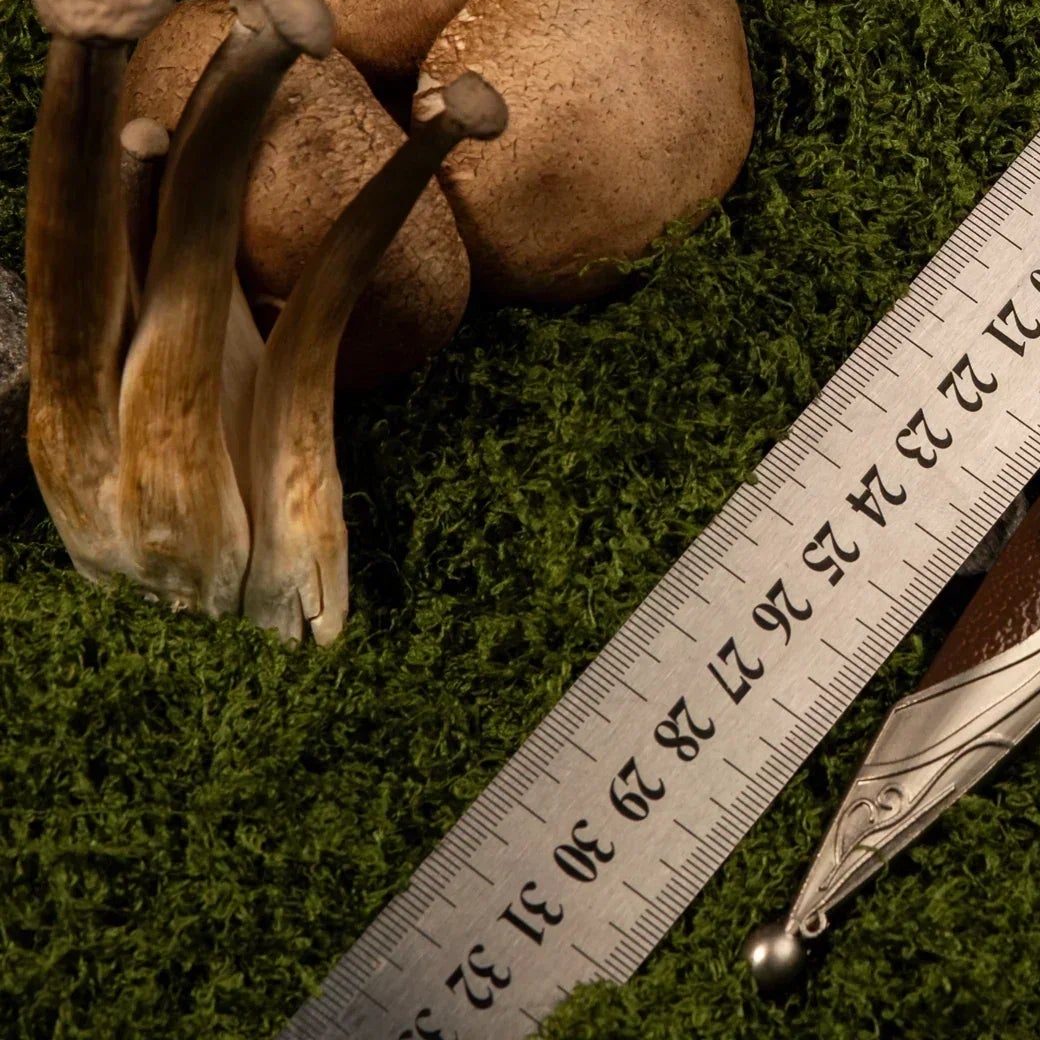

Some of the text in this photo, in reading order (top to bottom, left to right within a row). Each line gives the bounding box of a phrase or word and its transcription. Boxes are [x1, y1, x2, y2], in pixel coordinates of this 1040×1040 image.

[937, 353, 998, 412] 22
[896, 408, 953, 468] 23
[846, 464, 907, 527] 24
[803, 521, 860, 587] 25
[752, 578, 812, 646] 26
[707, 637, 764, 705] 27
[654, 696, 716, 761] 28
[609, 757, 666, 821] 29
[553, 819, 615, 883] 30
[498, 881, 564, 946] 31
[445, 945, 512, 1010] 32
